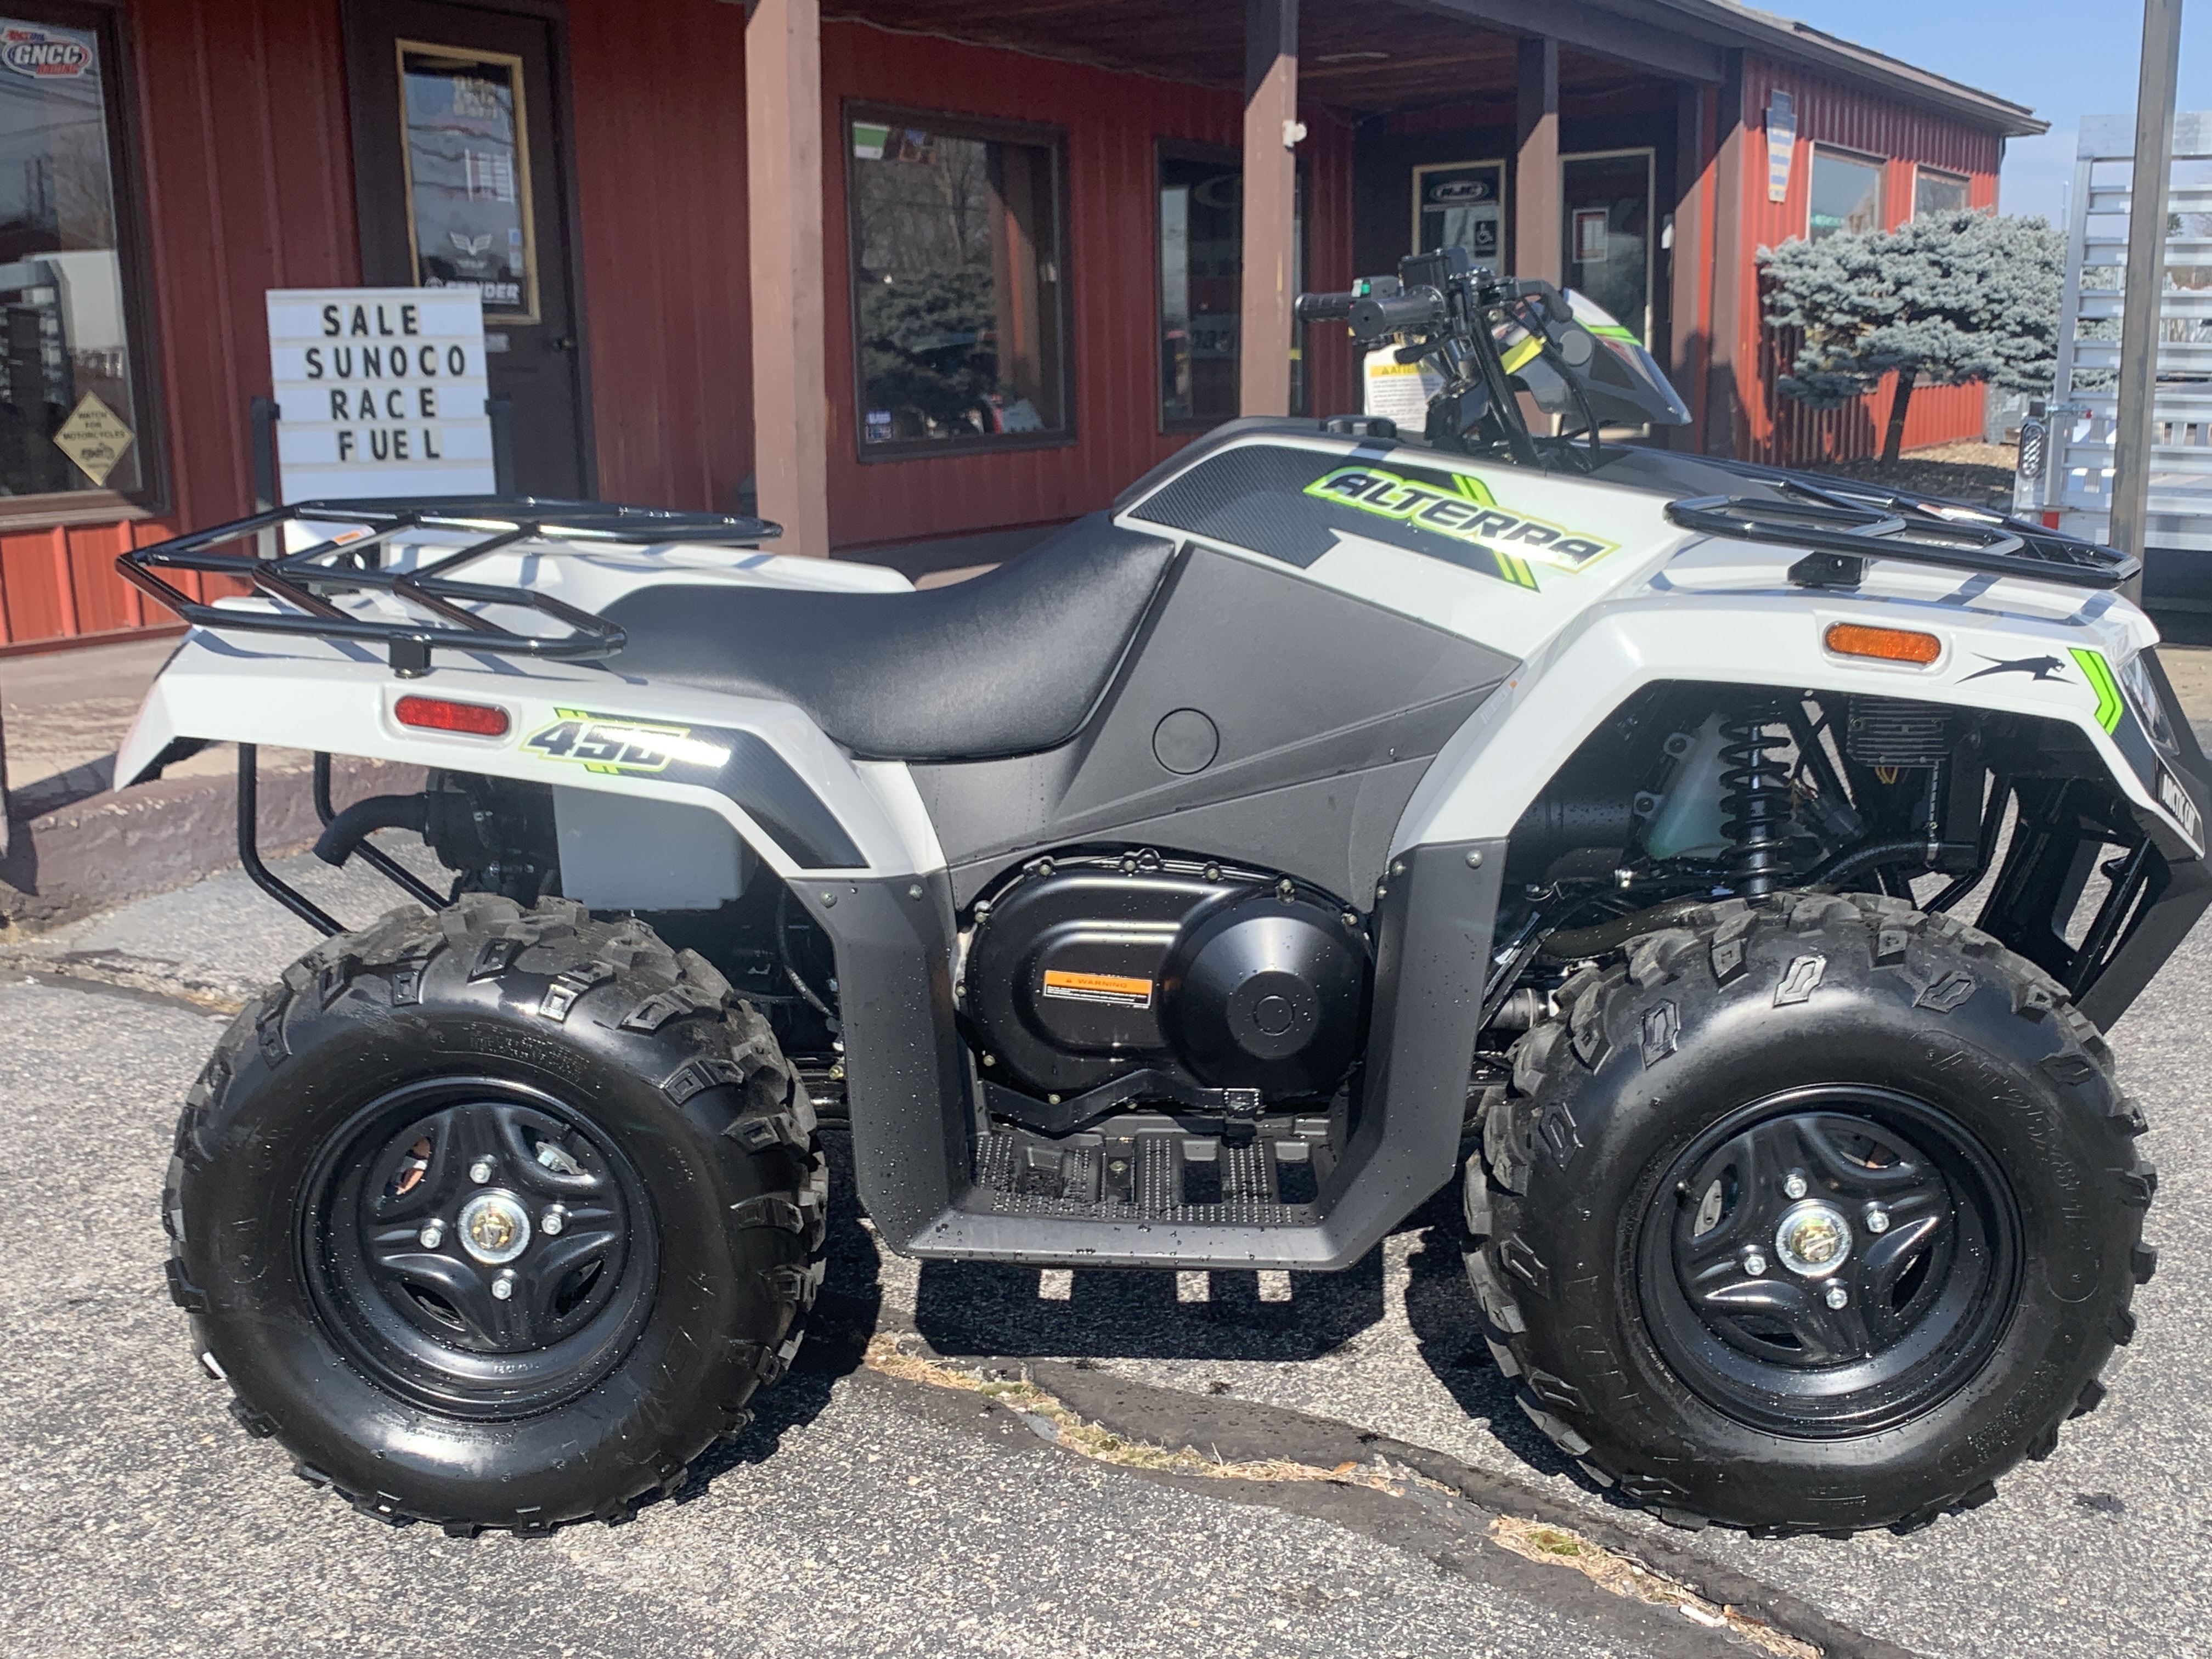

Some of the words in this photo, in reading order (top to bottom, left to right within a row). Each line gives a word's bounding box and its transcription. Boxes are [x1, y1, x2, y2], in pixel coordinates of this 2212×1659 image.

[14, 44, 80, 64] GNCC
[323, 304, 418, 337] SALE
[305, 345, 465, 379] SUNOCO
[330, 388, 436, 420] RACE
[338, 429, 441, 461] FUEL
[1319, 472, 1606, 565] ALTERRA
[1078, 978, 1127, 989] WARNING
